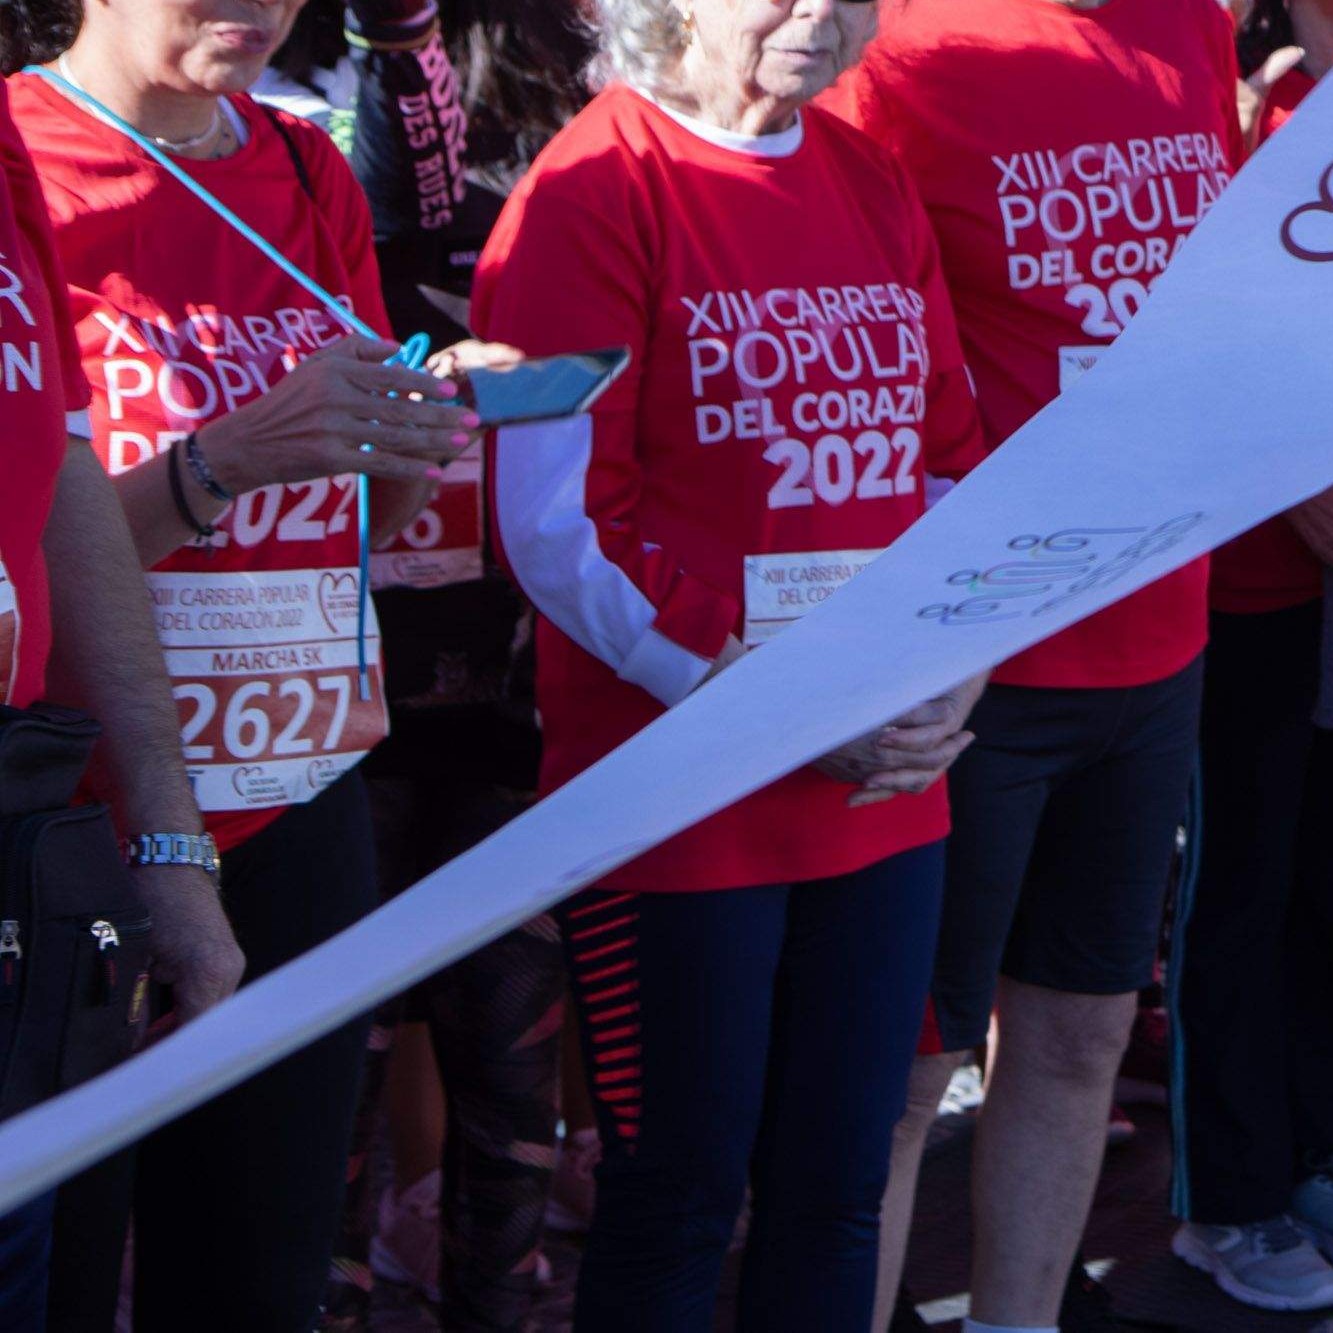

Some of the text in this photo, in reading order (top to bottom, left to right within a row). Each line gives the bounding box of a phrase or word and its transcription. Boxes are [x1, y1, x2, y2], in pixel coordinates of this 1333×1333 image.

[991, 132, 1229, 194] XIII CARRERA
[1007, 249, 1083, 290] DEL
[681, 289, 762, 337] XIII
[695, 397, 786, 445] DEL
[762, 426, 921, 509] 2022
[178, 585, 255, 607] CARRERA
[259, 582, 309, 604] POPULAR
[778, 587, 803, 606] DEL
[159, 612, 193, 632] DEL
[212, 647, 299, 672] MARCHA
[172, 674, 350, 760] 2627
